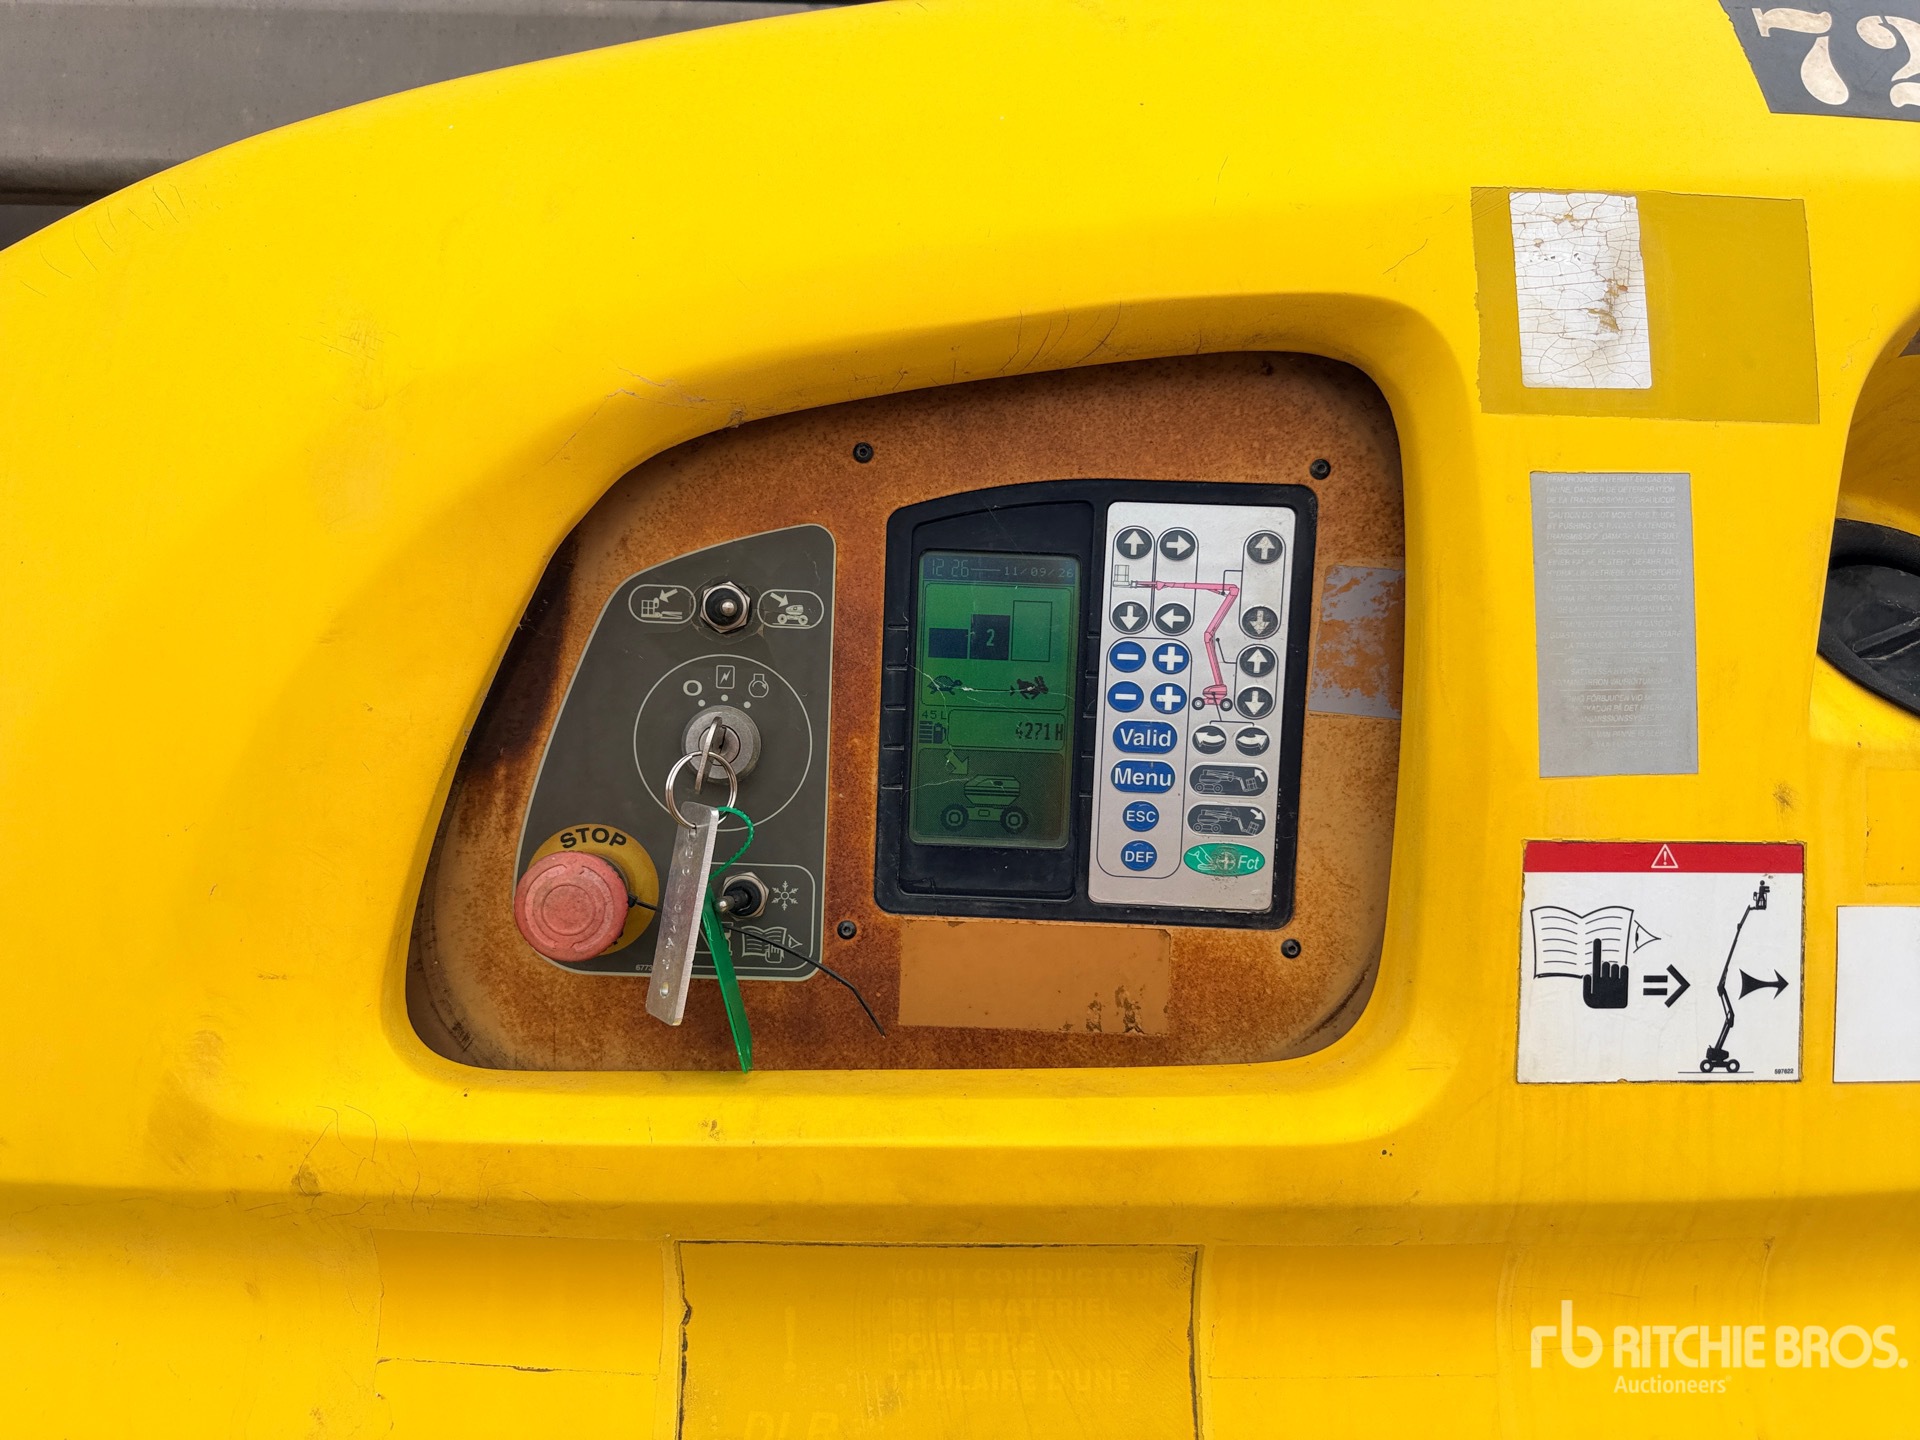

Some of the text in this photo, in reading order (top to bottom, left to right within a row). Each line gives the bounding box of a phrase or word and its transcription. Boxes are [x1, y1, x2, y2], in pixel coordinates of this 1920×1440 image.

[1004, 566, 1074, 579] 11/09/26
[985, 628, 996, 647] 2
[1120, 729, 1171, 747] Valid
[1114, 769, 1171, 787] Menu
[1126, 810, 1157, 824] ESC
[560, 827, 627, 849] STOP
[1124, 850, 1154, 864] DEF
[1237, 855, 1260, 870] Fct
